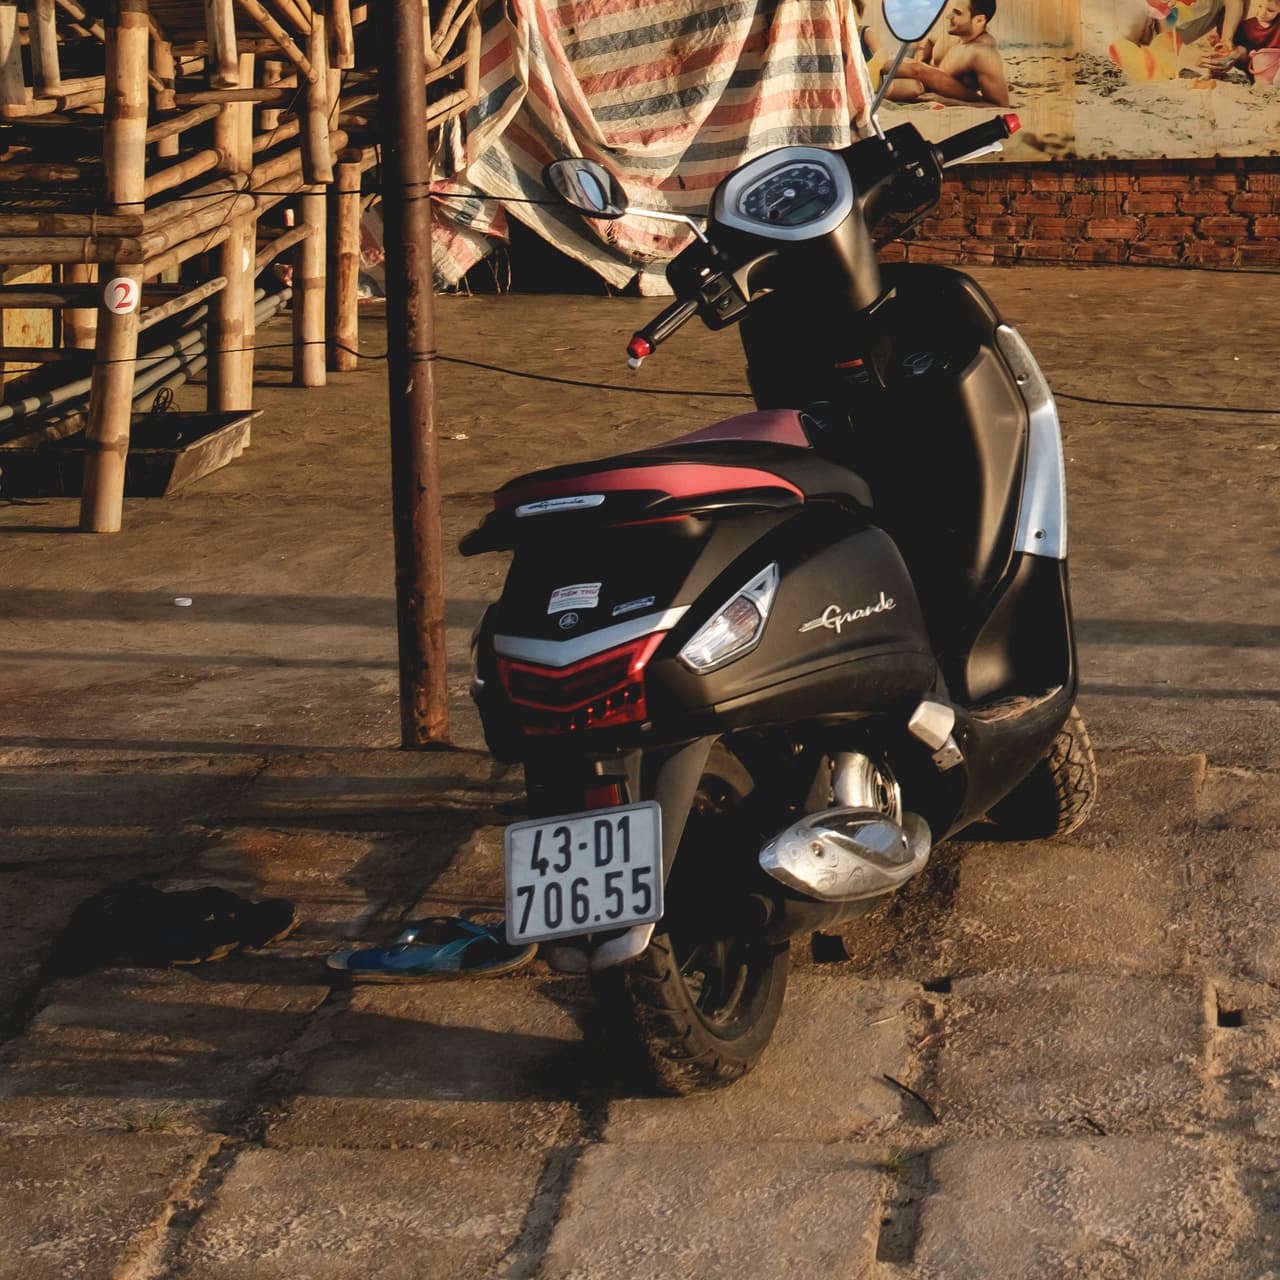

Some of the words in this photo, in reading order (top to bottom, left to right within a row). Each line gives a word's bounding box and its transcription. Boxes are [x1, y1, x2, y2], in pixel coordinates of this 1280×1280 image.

[113, 282, 133, 309] 2
[801, 591, 897, 634] Grande
[530, 815, 631, 877] 43-D1
[516, 866, 652, 935] 706.55
